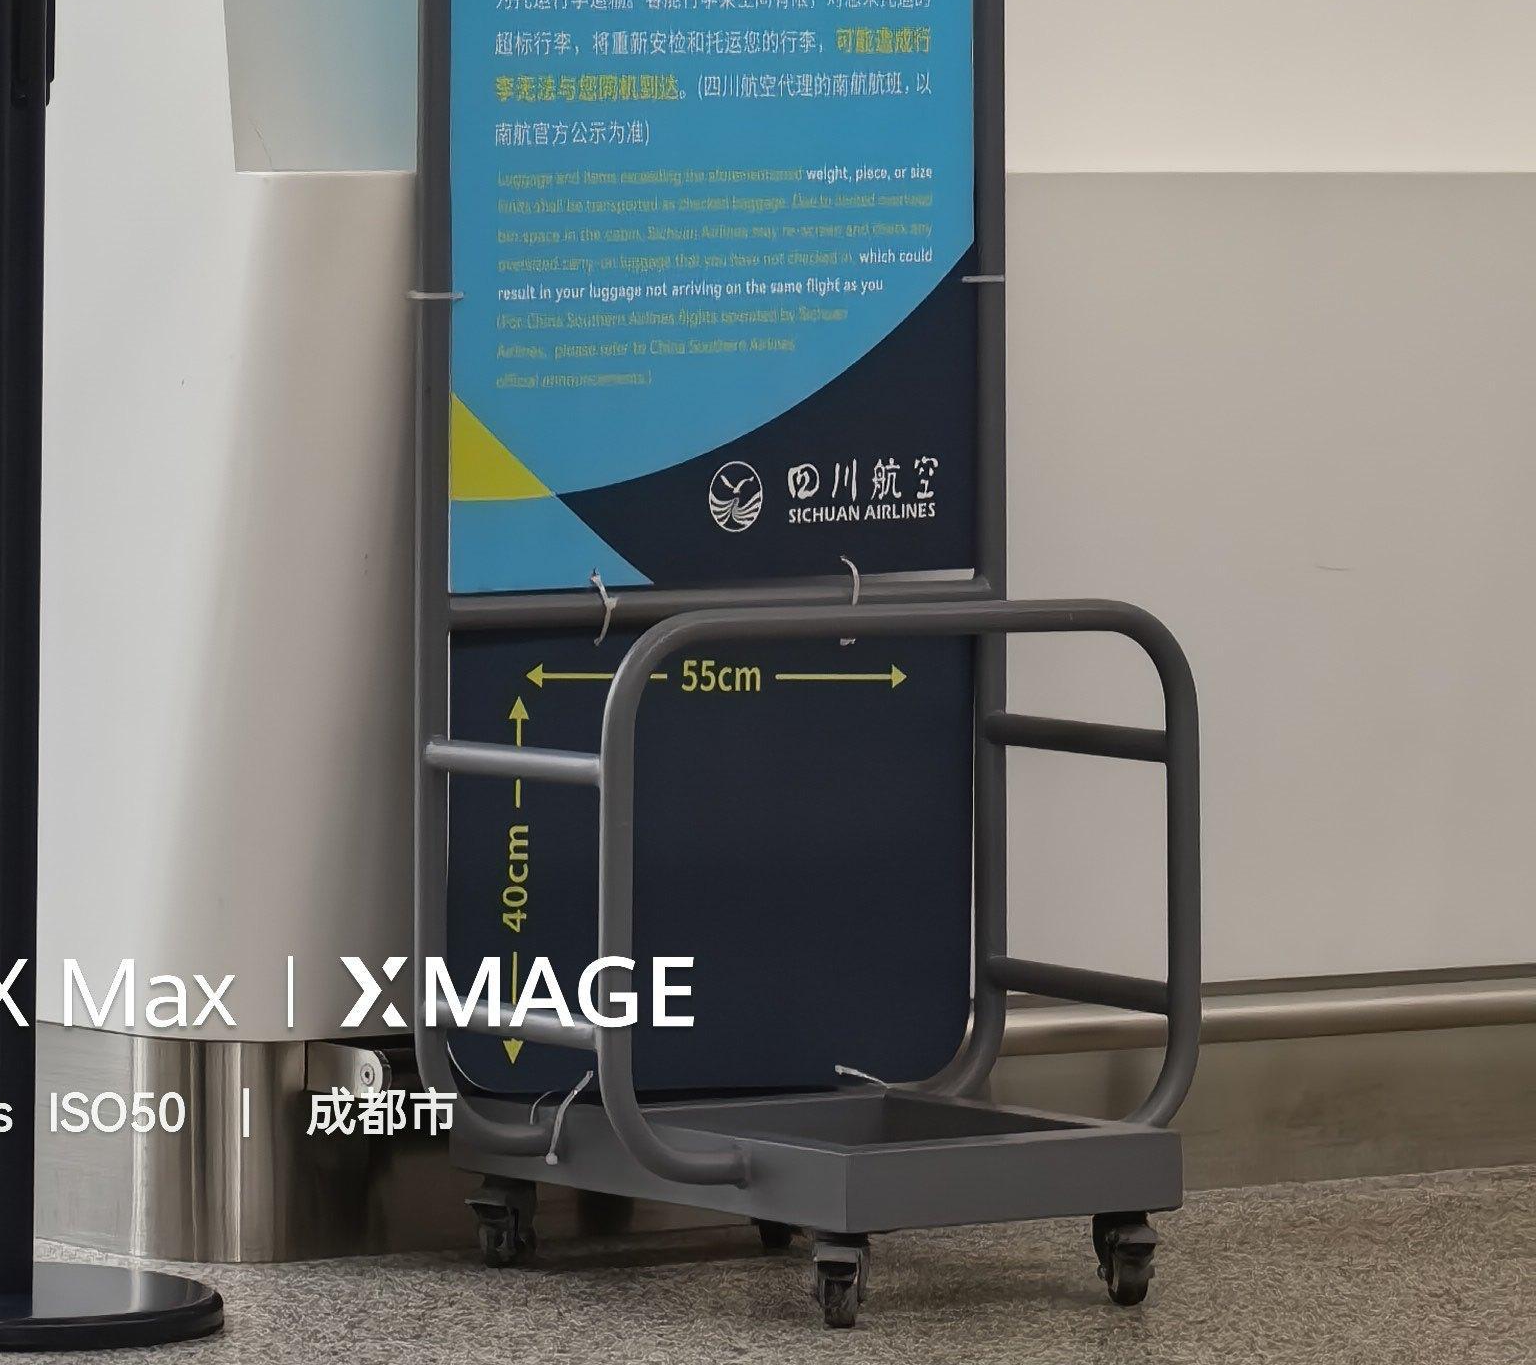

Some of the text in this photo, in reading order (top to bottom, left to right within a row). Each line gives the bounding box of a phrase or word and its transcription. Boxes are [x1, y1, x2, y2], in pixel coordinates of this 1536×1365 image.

[894, 168, 907, 179] or
[859, 248, 896, 263] which
[899, 248, 932, 263] could
[498, 277, 883, 303] result in your luggage not arriving on the same flight as you
[787, 456, 939, 501] 四川航空
[789, 502, 936, 524] SICHUAN AIRLINES
[680, 660, 761, 692] 55cm
[502, 824, 529, 933] 40cm
